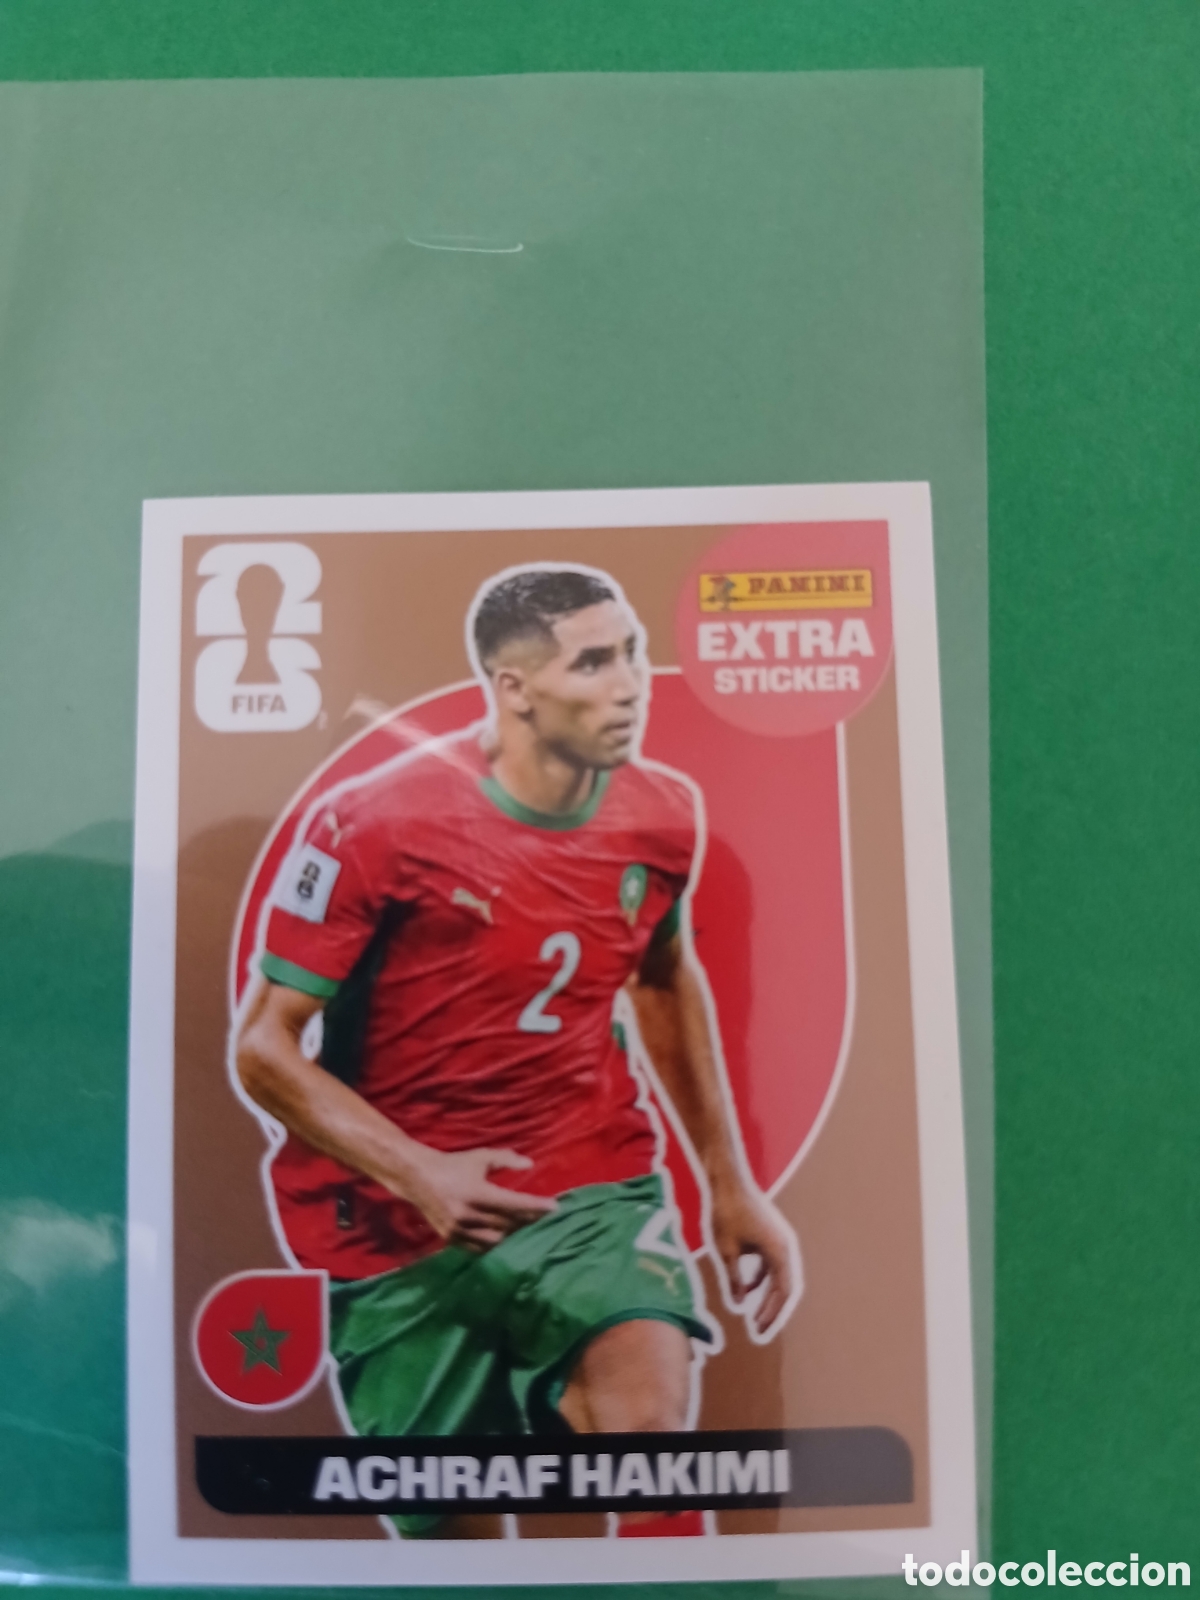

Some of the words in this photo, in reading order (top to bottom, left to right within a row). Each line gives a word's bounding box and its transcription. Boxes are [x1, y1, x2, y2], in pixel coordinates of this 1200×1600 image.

[748, 574, 865, 594] PANINI
[698, 618, 874, 661] EXTRA
[714, 664, 860, 694] STICKER
[231, 694, 287, 714] FIFA
[517, 931, 581, 1033] 2
[314, 1455, 560, 1500] ACHRAF
[571, 1449, 791, 1497] HAKIMI
